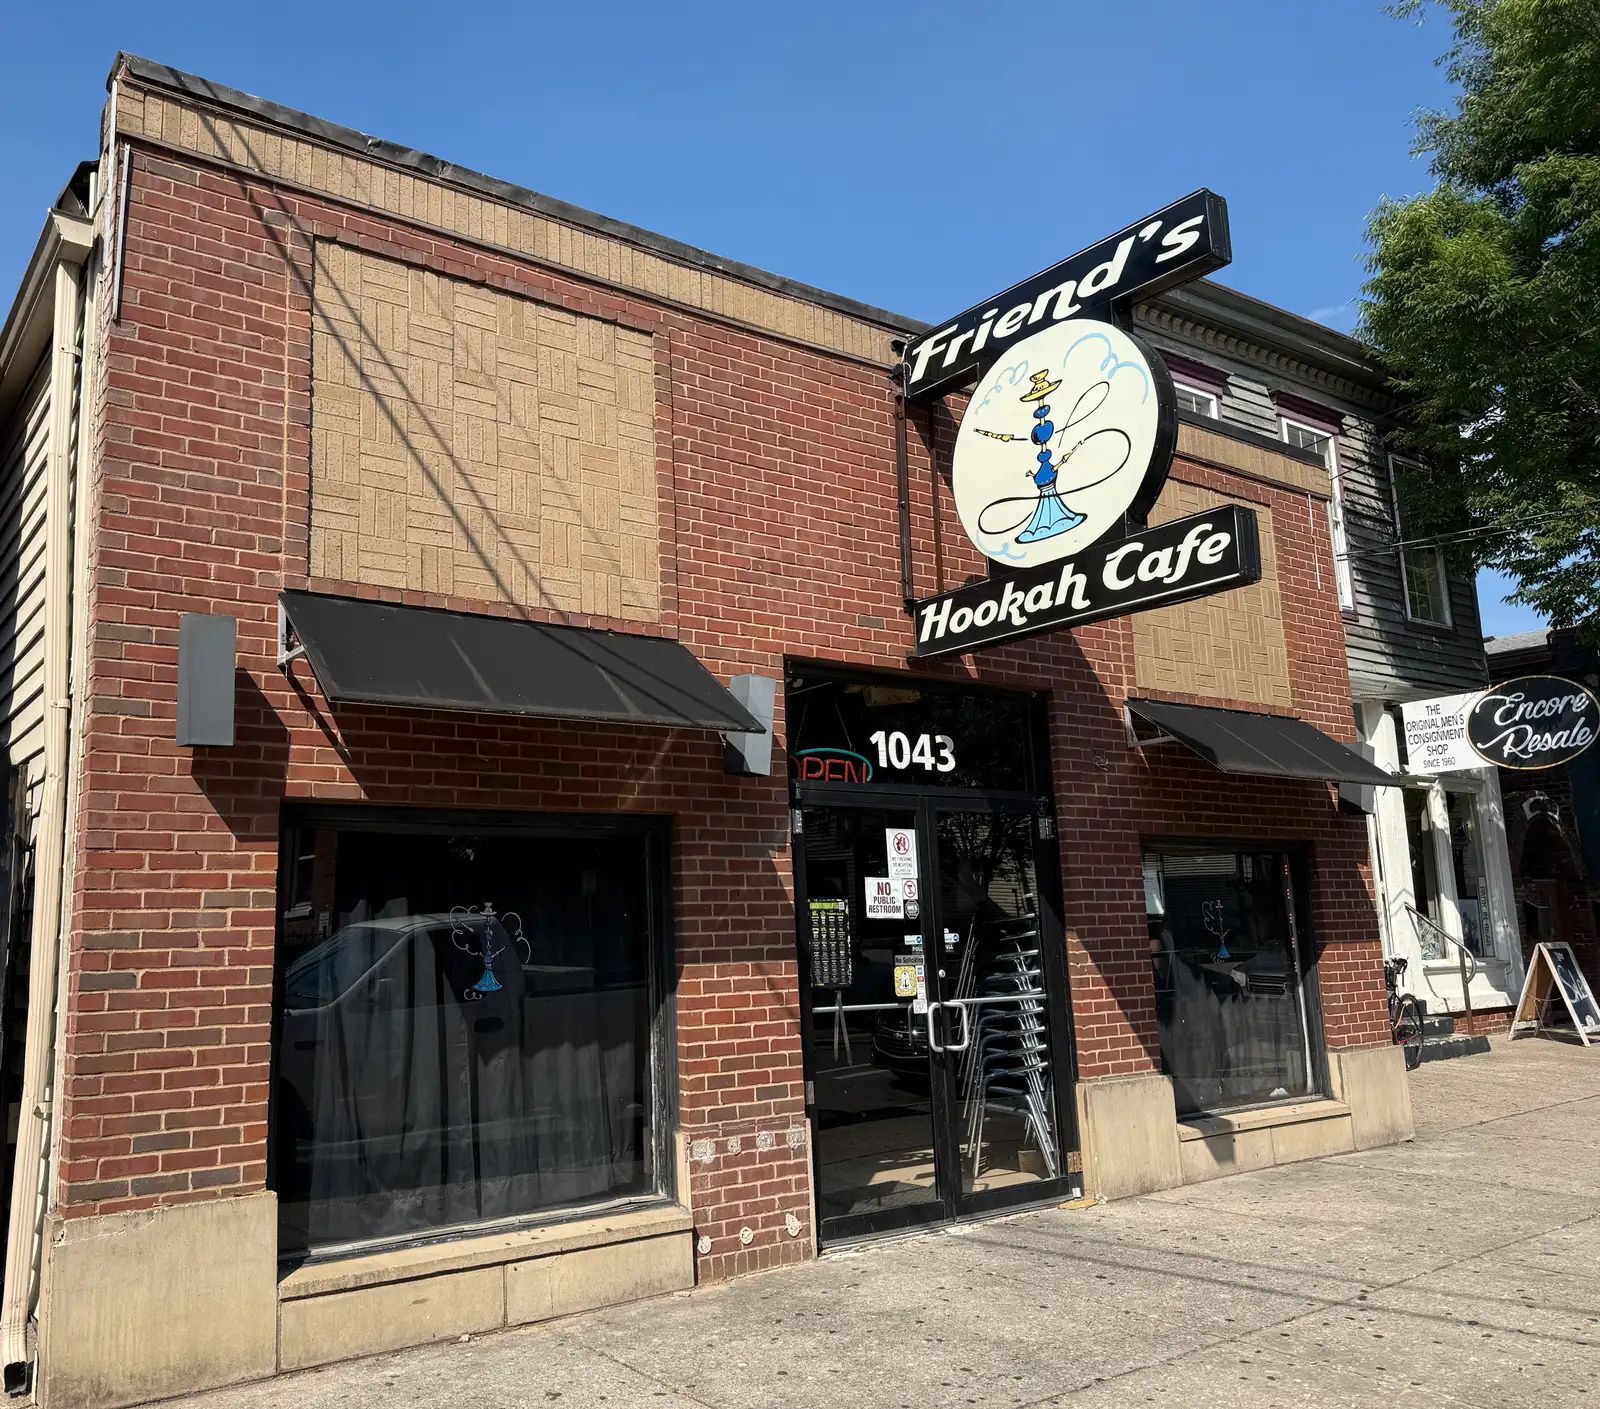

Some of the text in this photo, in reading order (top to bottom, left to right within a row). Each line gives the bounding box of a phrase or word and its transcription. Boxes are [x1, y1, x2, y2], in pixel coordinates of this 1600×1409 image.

[908, 215, 1206, 385] Friend's
[919, 522, 1232, 644] Hookah Cafe
[1425, 704, 1441, 716] THE
[1475, 692, 1590, 727] Encore
[1406, 713, 1465, 732] ORIGINAL MENS
[1408, 727, 1465, 745] CONSIGNMENT
[1476, 716, 1593, 760] Resale
[869, 730, 956, 773] 1043
[1426, 743, 1449, 757] SHOP
[1423, 758, 1441, 768] SINCE
[877, 881, 892, 896] NO
[868, 904, 902, 914] RESTROOM
[873, 896, 896, 905] PUBLIC
